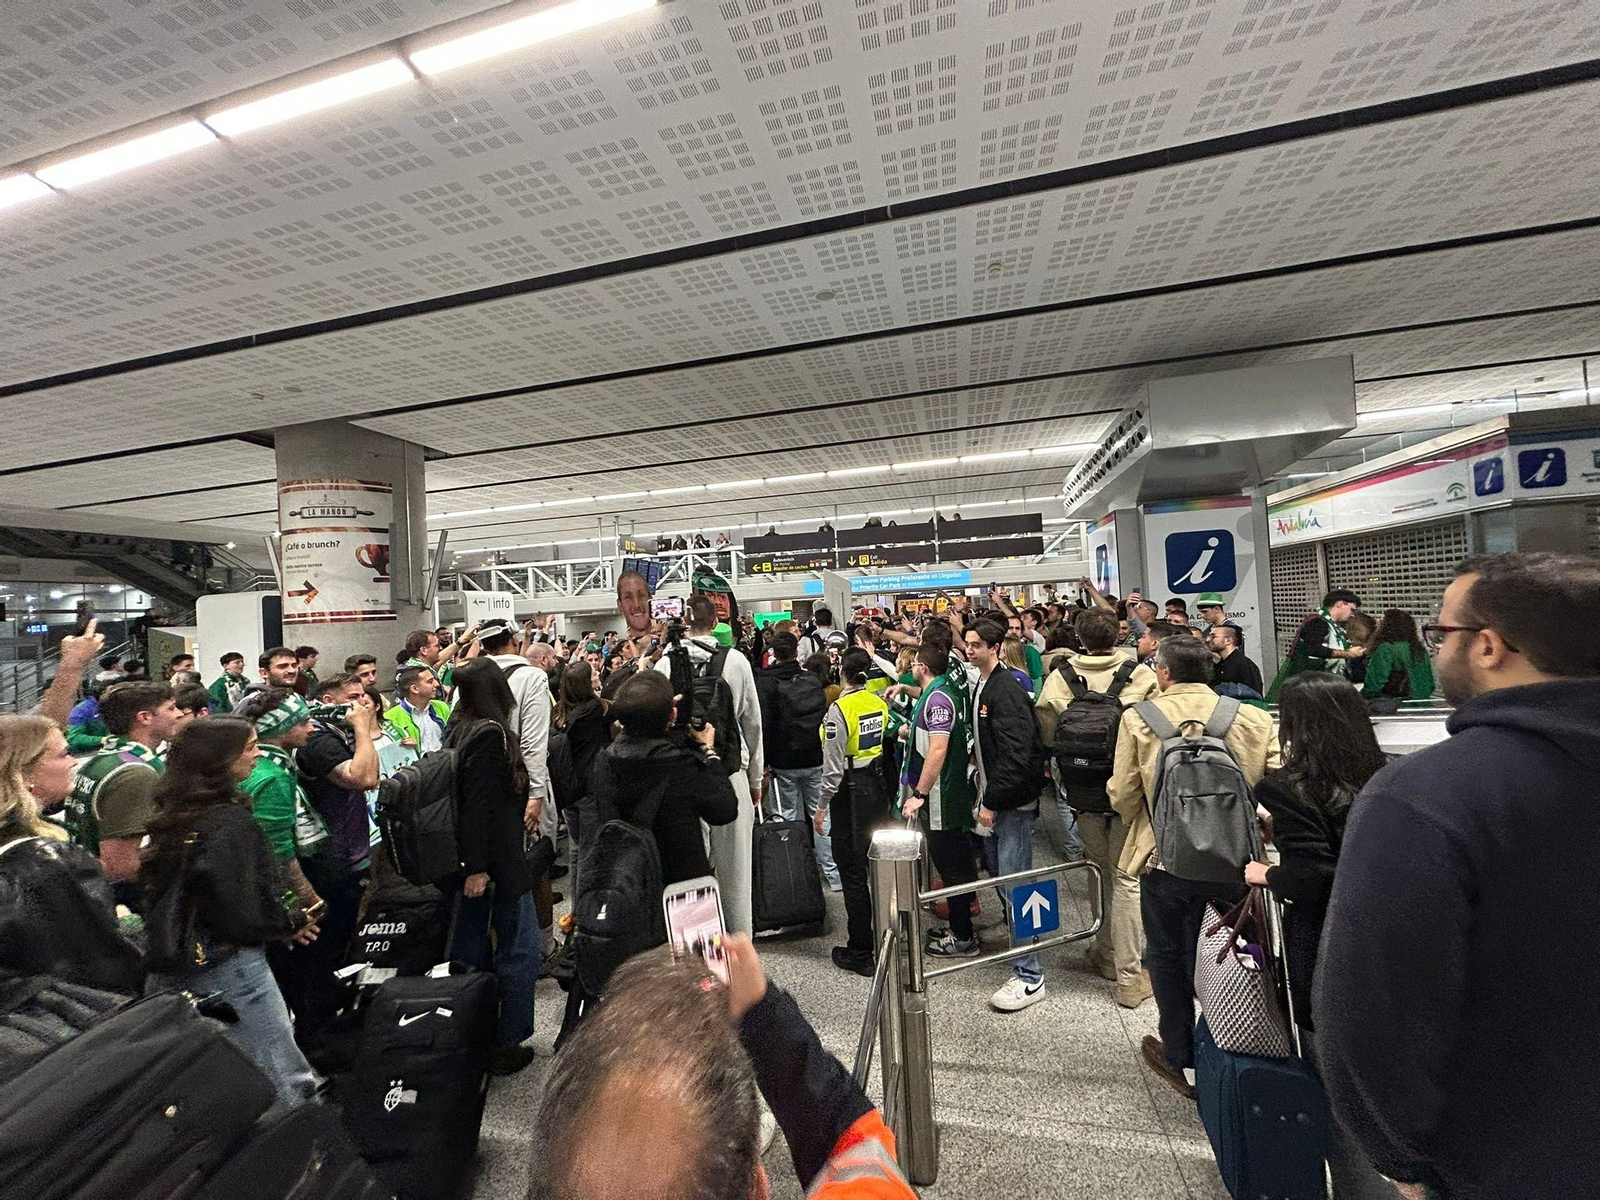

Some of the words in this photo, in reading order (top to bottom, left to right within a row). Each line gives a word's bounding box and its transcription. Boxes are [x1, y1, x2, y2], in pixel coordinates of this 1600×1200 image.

[307, 508, 316, 516] LA
[320, 508, 347, 516] MANON
[285, 543, 300, 552] ¿Café
[307, 540, 341, 549] brunch?
[493, 597, 510, 609] info
[1225, 611, 1246, 619] ISMO
